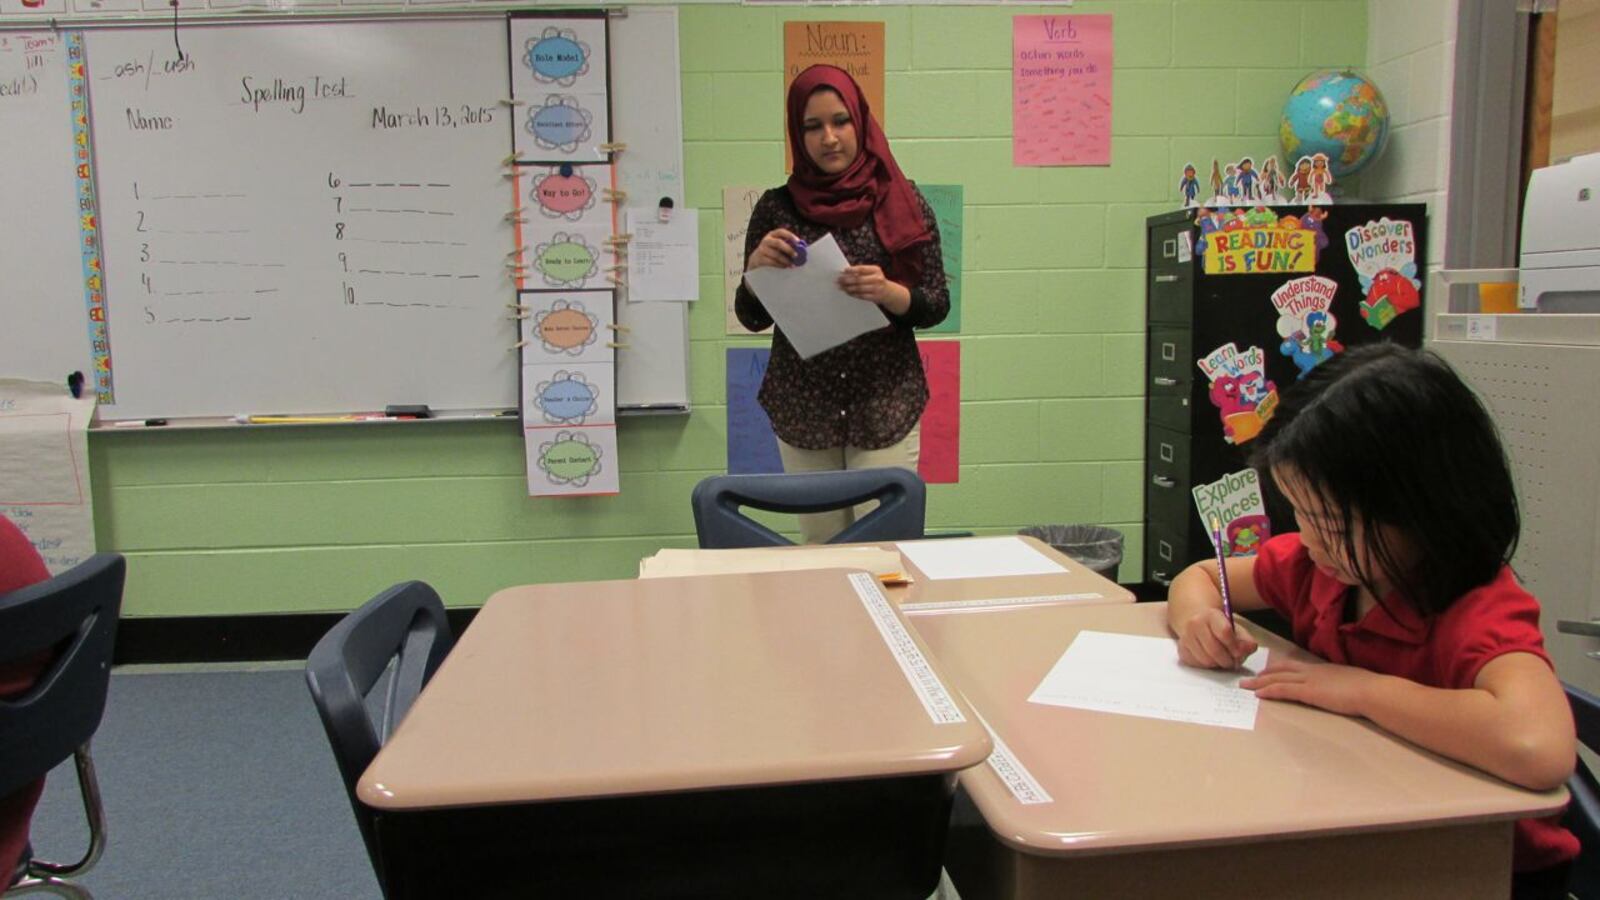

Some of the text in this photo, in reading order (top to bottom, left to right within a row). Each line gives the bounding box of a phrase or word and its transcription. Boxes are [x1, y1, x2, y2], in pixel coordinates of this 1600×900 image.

[806, 23, 866, 53] Noun:
[1043, 18, 1077, 41] Verb
[241, 77, 304, 114] Spelling
[126, 107, 173, 130] Name
[372, 106, 429, 129] March
[328, 171, 341, 189] 6
[332, 196, 342, 213] 7
[543, 189, 556, 198] Way
[136, 210, 147, 232] 2
[336, 222, 345, 240] 8
[1215, 231, 1304, 253] READING
[1350, 222, 1409, 250] Discover
[140, 243, 150, 262] 3
[1243, 251, 1303, 271] FUN!
[1273, 277, 1335, 309] Understand
[1285, 296, 1326, 316] Things
[1199, 346, 1236, 375] Learn
[1194, 470, 1257, 514] Explore
